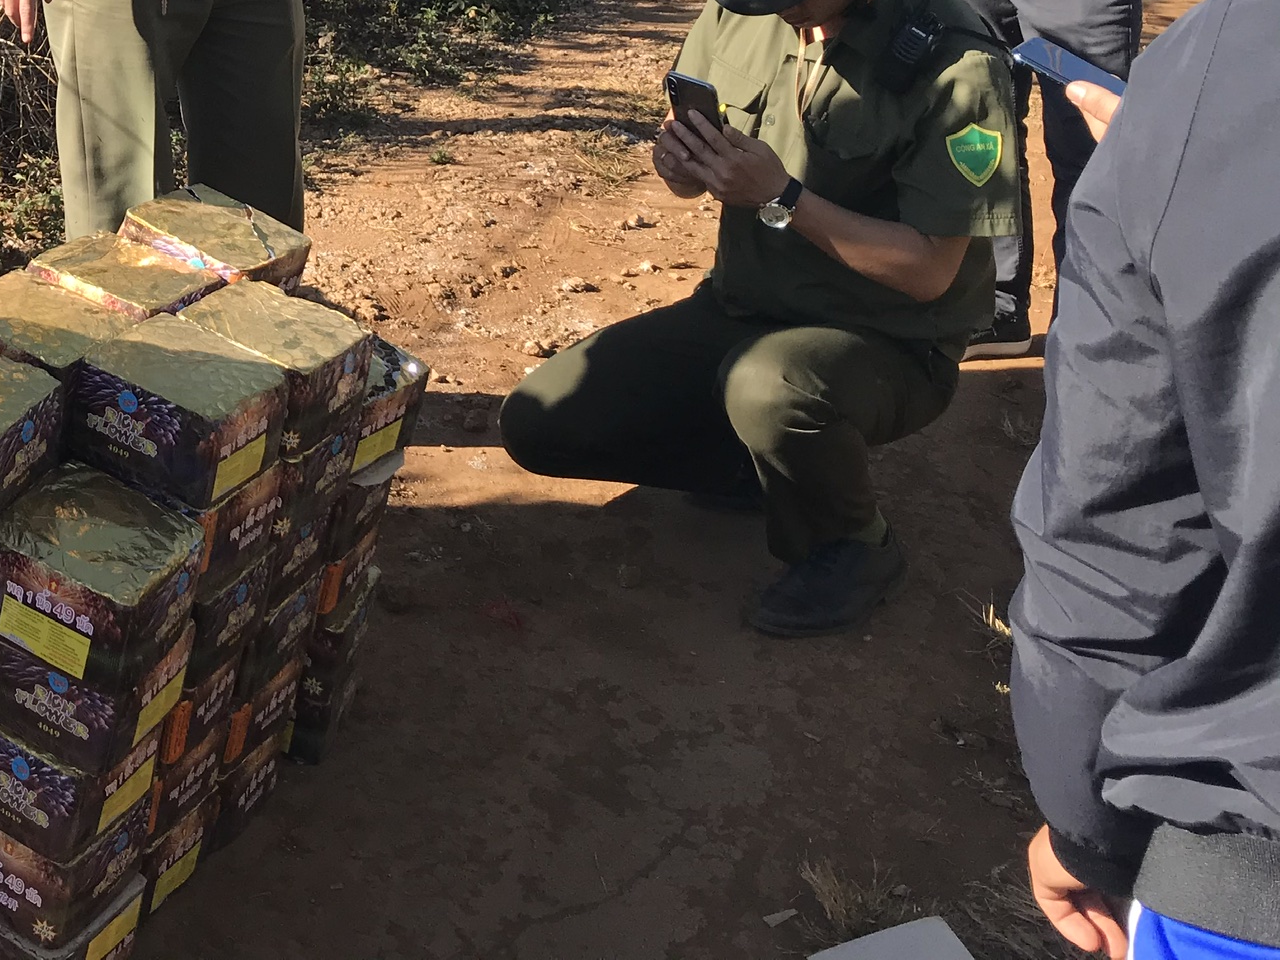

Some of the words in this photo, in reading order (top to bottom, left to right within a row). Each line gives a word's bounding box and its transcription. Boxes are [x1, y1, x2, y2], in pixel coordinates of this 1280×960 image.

[86, 412, 158, 458] FLOWER
[108, 444, 130, 458] 4049
[26, 590, 33, 604] 1
[52, 602, 75, 624] 49
[14, 687, 90, 741] FLOWER
[37, 721, 61, 738] 4049
[0, 807, 22, 824] 4049
[4, 873, 25, 895] 49
